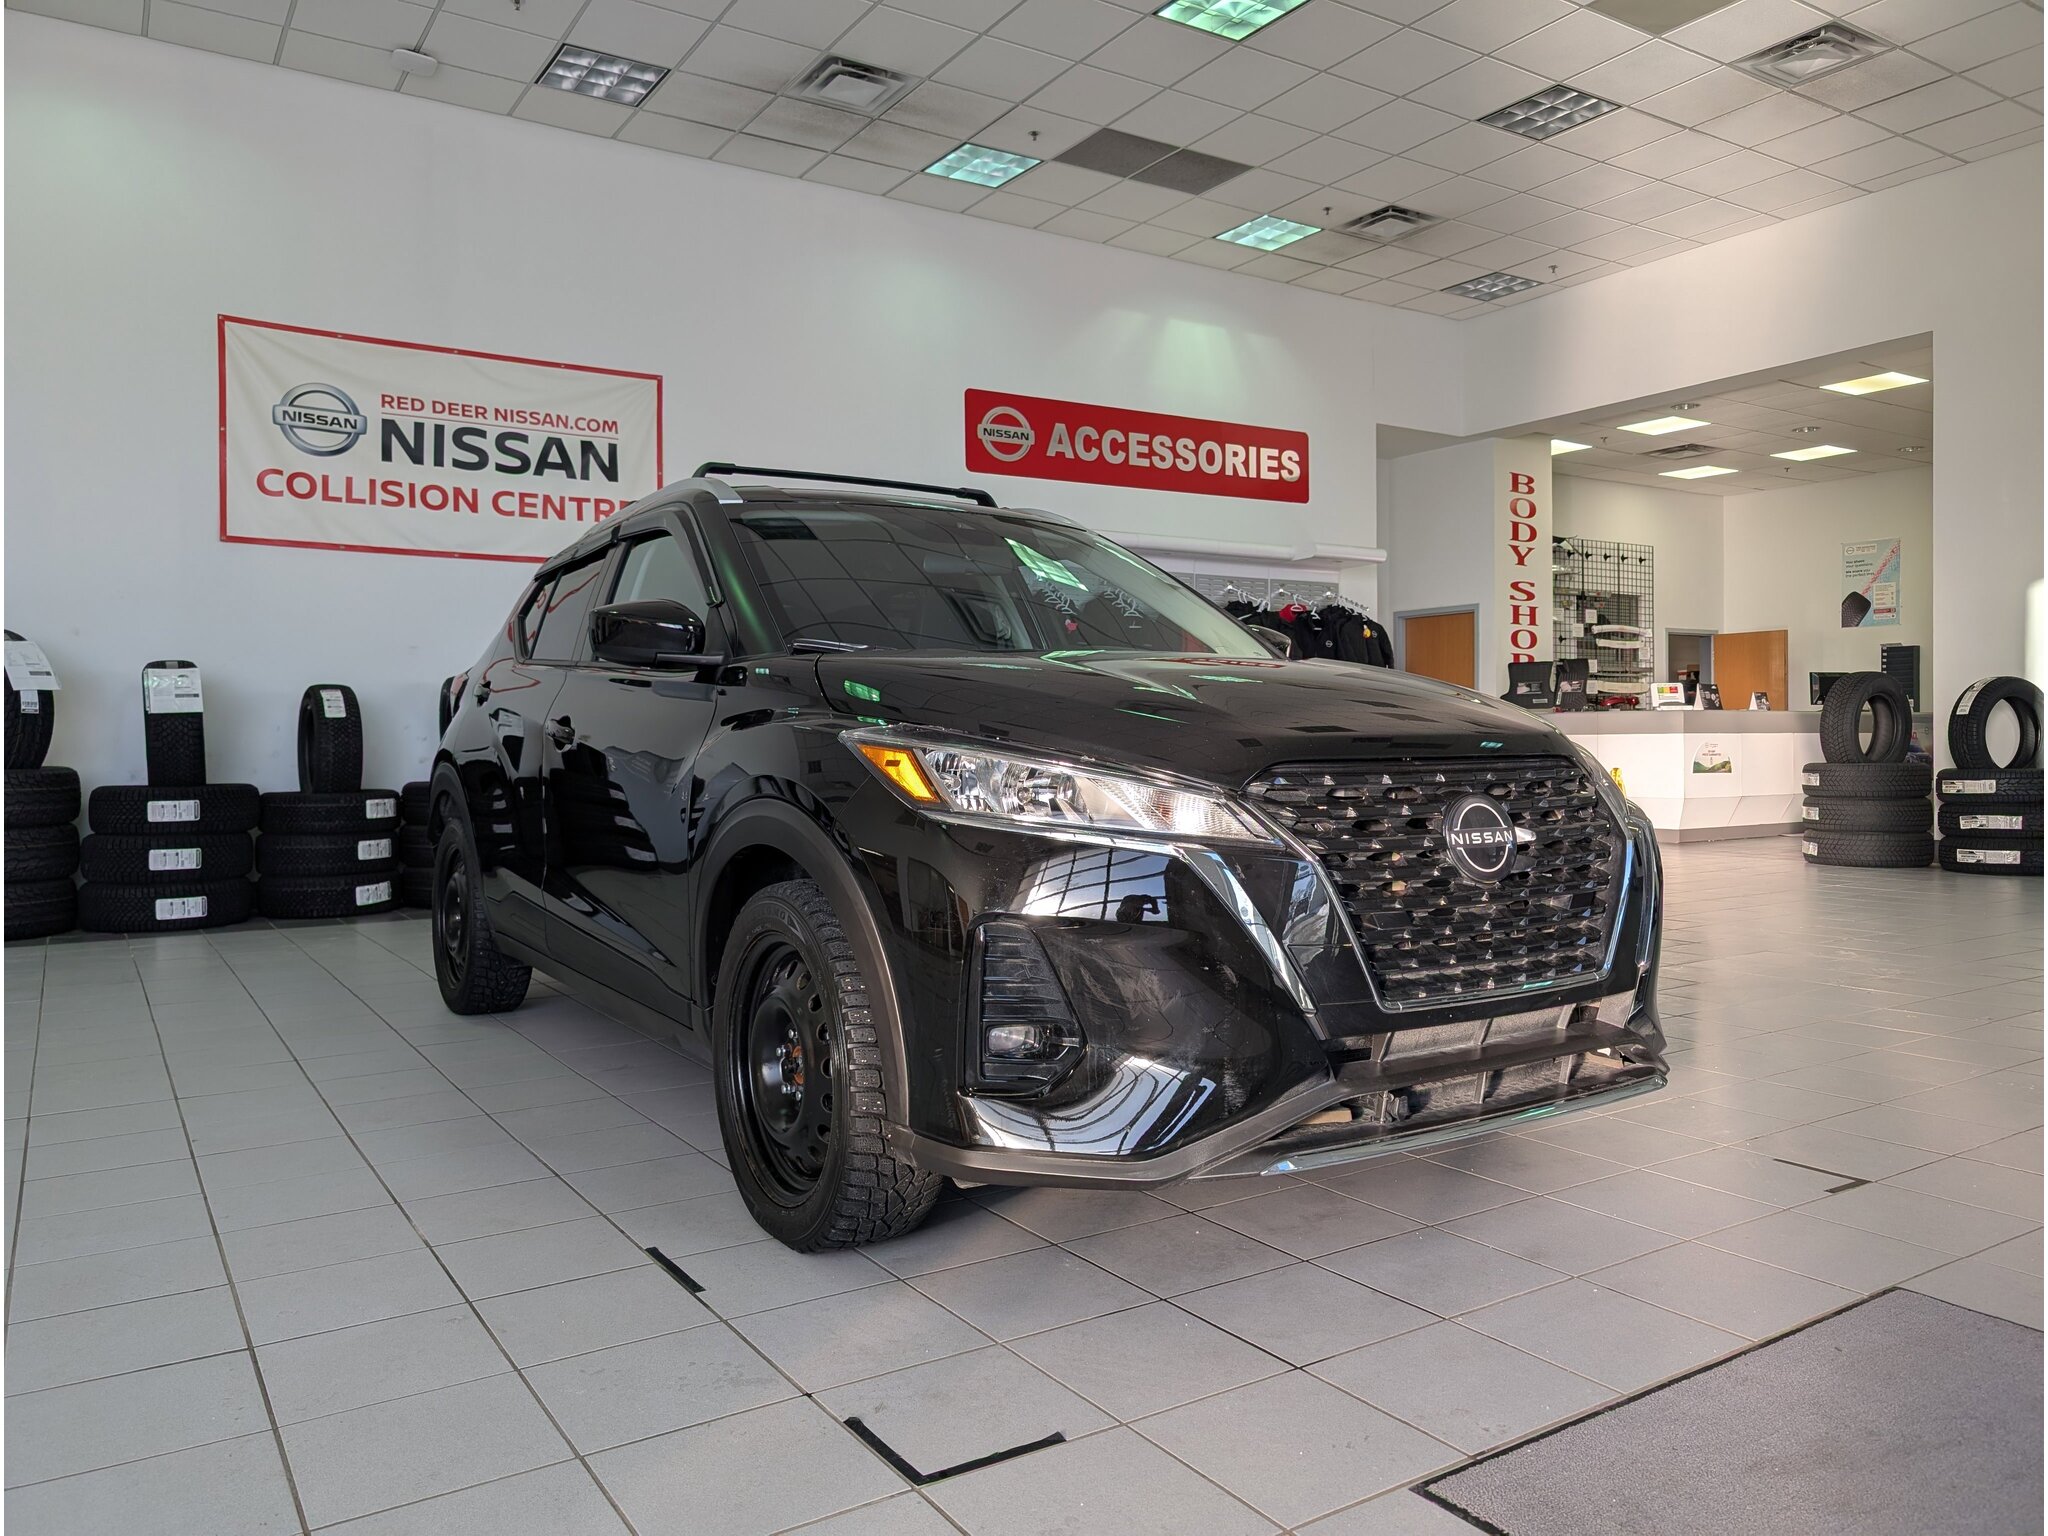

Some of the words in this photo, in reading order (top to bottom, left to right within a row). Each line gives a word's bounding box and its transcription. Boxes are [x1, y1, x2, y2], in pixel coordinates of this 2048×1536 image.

[282, 409, 358, 430] NISSAN
[381, 393, 425, 412] RED
[432, 400, 488, 420] DEER
[494, 408, 619, 435] NISSAN.COM
[983, 427, 1030, 441] NISSAN
[381, 417, 619, 483] NISSAN
[1046, 422, 1301, 482] ACCESSORIES
[256, 467, 479, 514] COLLISION
[1507, 471, 1538, 567] BODY
[1450, 830, 1514, 846] NISSAN
